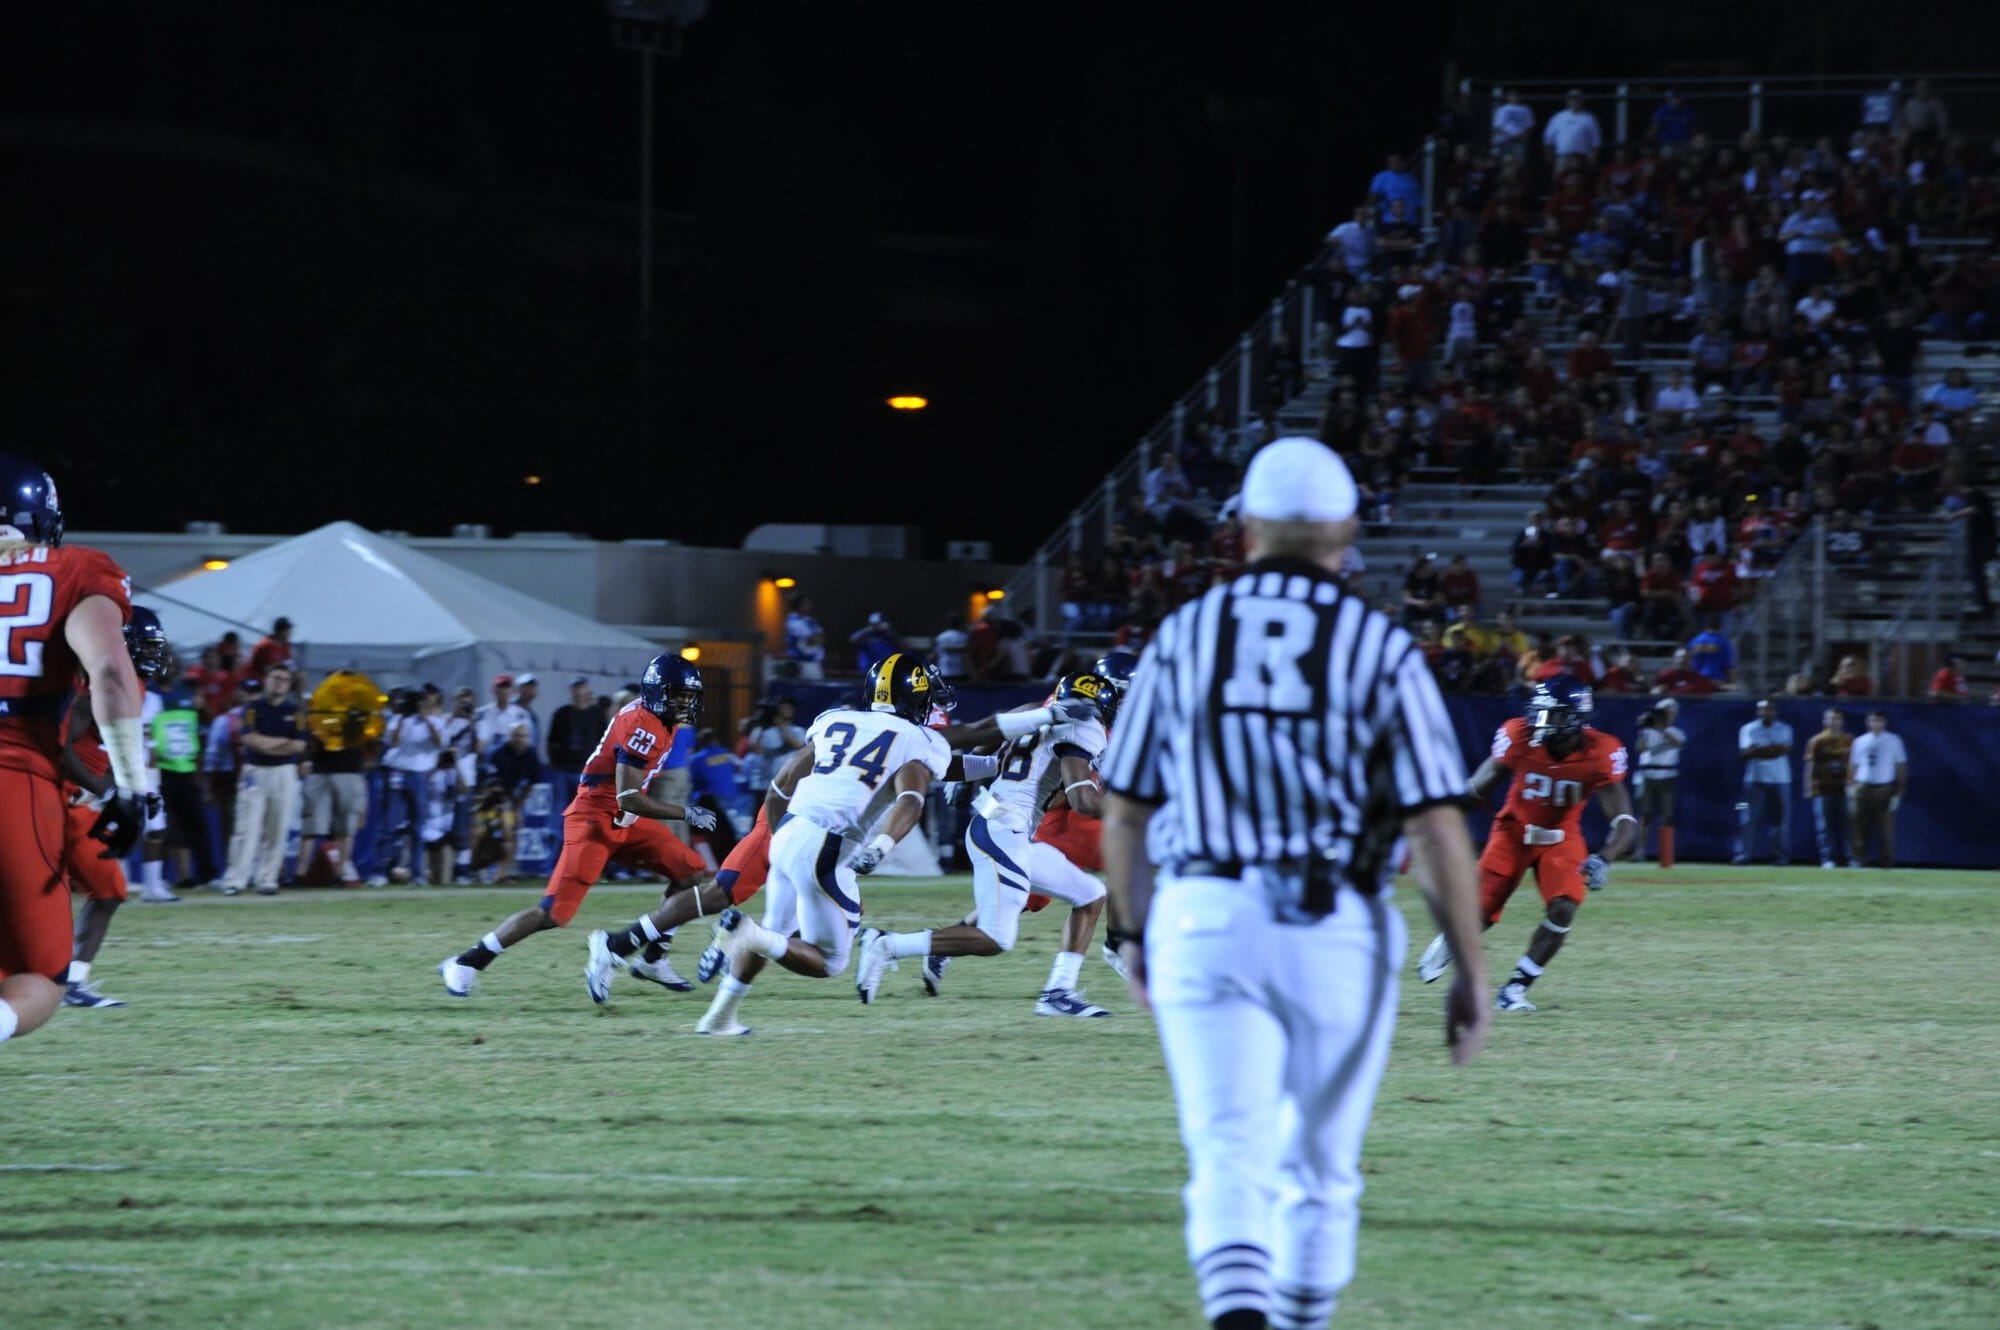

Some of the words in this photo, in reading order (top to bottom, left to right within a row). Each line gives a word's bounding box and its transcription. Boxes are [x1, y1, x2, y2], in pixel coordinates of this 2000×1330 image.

[1223, 597, 1318, 712] R
[1071, 675, 1106, 698] Cal
[626, 727, 656, 756] 23
[814, 722, 899, 790] 34
